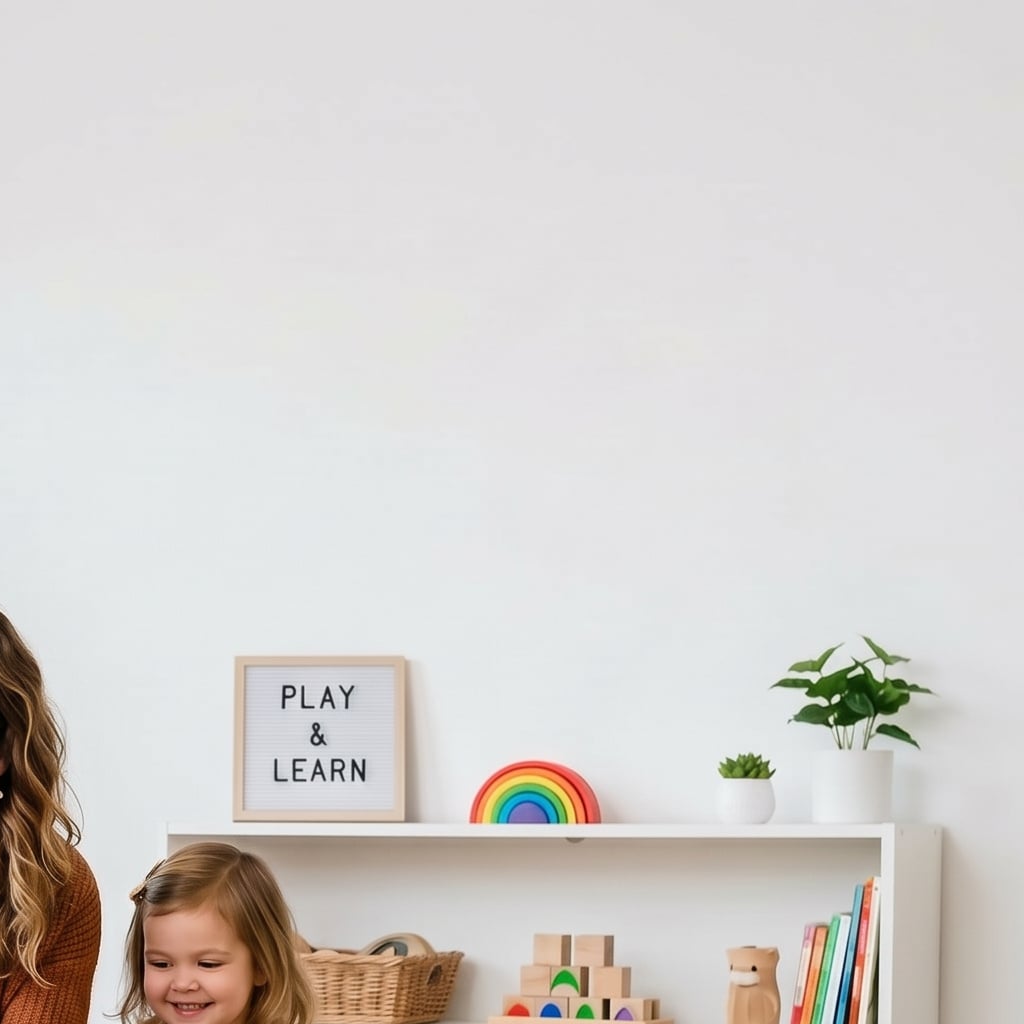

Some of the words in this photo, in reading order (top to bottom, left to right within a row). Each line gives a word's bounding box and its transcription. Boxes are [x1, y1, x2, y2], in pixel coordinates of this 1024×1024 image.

[281, 684, 355, 710] PLAY
[310, 721, 328, 747] &
[273, 758, 367, 783] LEARN
